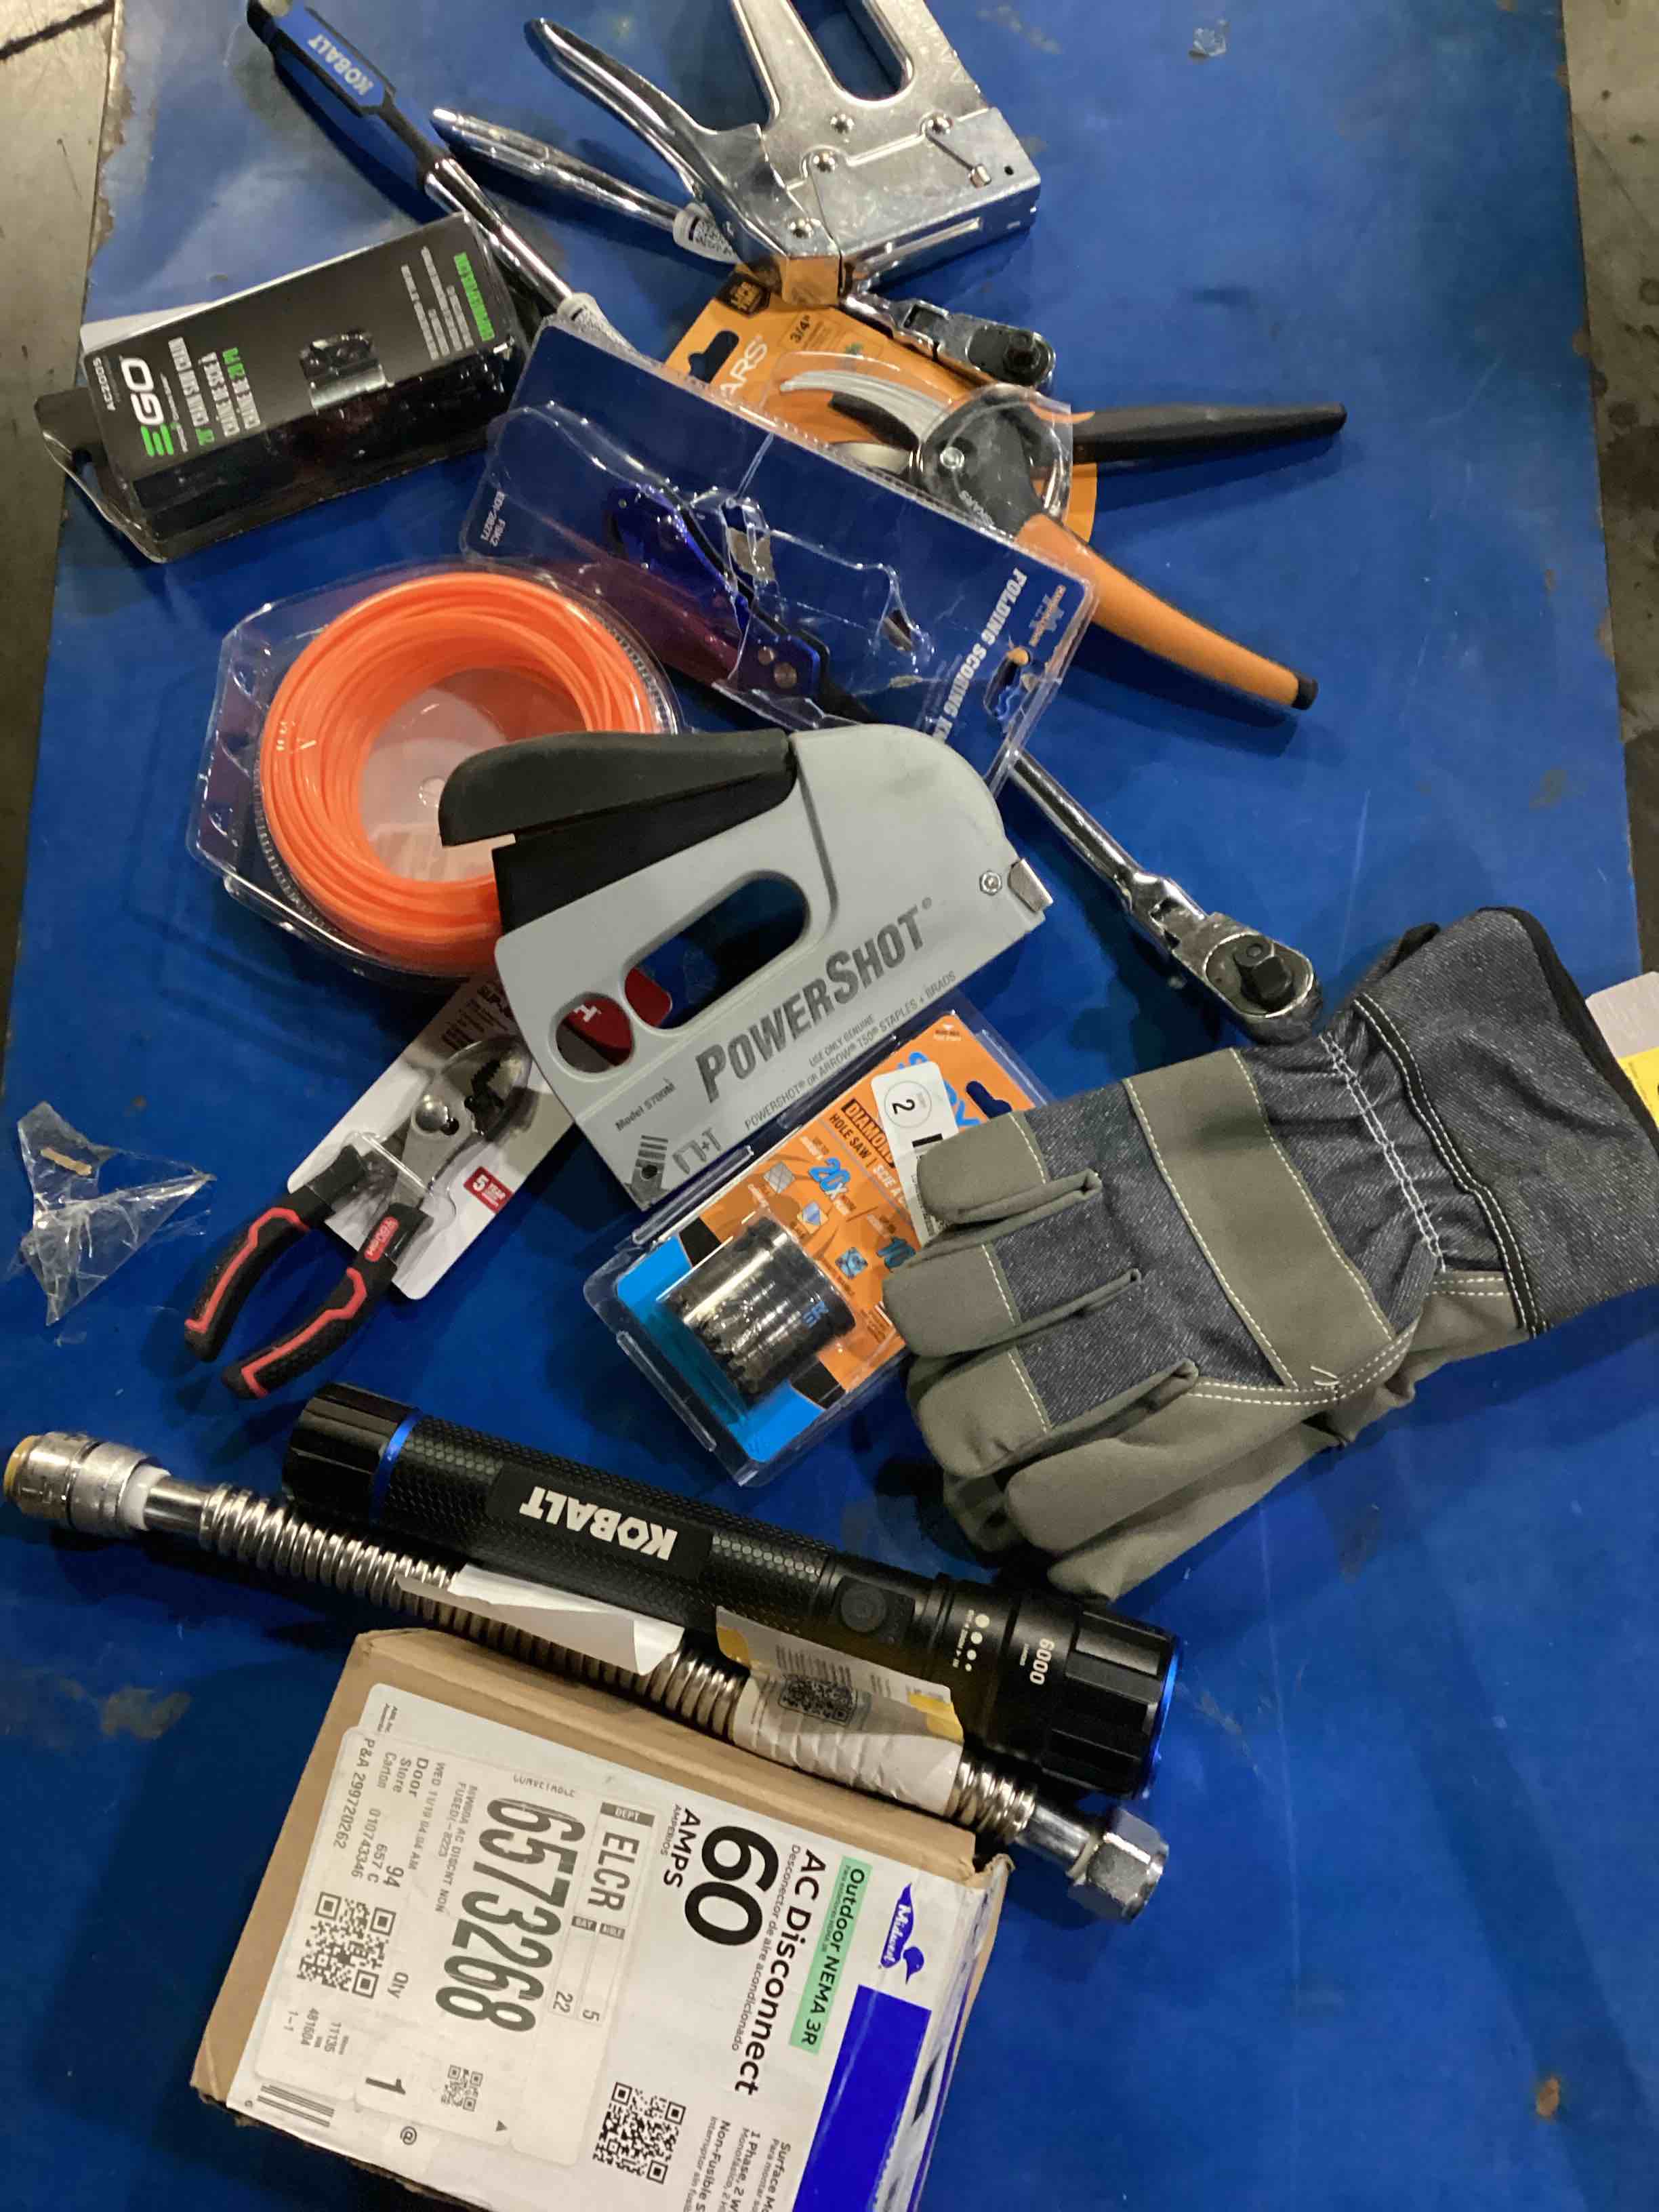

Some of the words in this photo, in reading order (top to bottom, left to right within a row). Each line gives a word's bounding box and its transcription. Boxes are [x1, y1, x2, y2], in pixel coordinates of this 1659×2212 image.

[306, 29, 375, 97] KOBALT
[167, 335, 192, 371] CHAIN
[178, 369, 200, 396] SAW
[118, 352, 176, 461] EGO
[185, 393, 209, 427] CHAIN
[978, 567, 1029, 646] FOLDING
[939, 641, 990, 718] SCORING
[877, 997, 919, 1032] STAPLES
[924, 970, 958, 1000] BRADS
[614, 1104, 645, 1132] Model
[891, 1099, 916, 1117] 2
[827, 1112, 855, 1139] HOLE
[848, 1135, 872, 1160] SAW
[472, 1174, 489, 1193] 5
[518, 1483, 678, 1561] KOBALT
[1028, 1637, 1056, 1685] 6000
[356, 1736, 375, 1769] P&A
[375, 1750, 396, 1790] Carton
[392, 1757, 411, 1794] Store
[407, 1757, 429, 1799] Door
[430, 1761, 445, 1786] WED
[332, 1771, 365, 1849] 299720262
[659, 1803, 682, 1856] AMPERIOS
[350, 1807, 381, 1879] 010743346
[453, 1827, 465, 1843] AC
[661, 1807, 703, 1889] AMPS
[371, 1843, 388, 1869] 657
[407, 1851, 420, 1870] AM
[442, 1845, 460, 1885] DISCNT
[586, 1830, 640, 1914] ELCR
[792, 1849, 829, 1901] AC
[367, 1872, 380, 1884] C
[382, 1864, 405, 1889] 94
[676, 1818, 787, 1954] 60
[769, 1843, 800, 1919] Desconector
[430, 1792, 590, 2039] 6573268
[434, 1888, 449, 1913] NON
[827, 1866, 867, 1953] Outdoor
[764, 1919, 778, 1937] de
[882, 1903, 912, 1963] Midwest
[757, 1936, 773, 1962] aire
[386, 1969, 409, 2000] Qty
[551, 1989, 574, 2014] 22
[731, 1904, 813, 2098] Disconnect
[809, 1954, 840, 2016] NEMA
[300, 2007, 320, 2047] 481604
[580, 2007, 600, 2022] 5
[729, 1962, 765, 2052] acondicionado
[323, 2020, 342, 2053] 11135
[800, 2018, 821, 2047] 3R
[363, 2069, 409, 2096] 1
[697, 2119, 731, 2201] Non-Fusible
[735, 2140, 758, 2185] Phase,
[766, 2141, 792, 2194] Surface
[733, 2186, 744, 2196] 2
